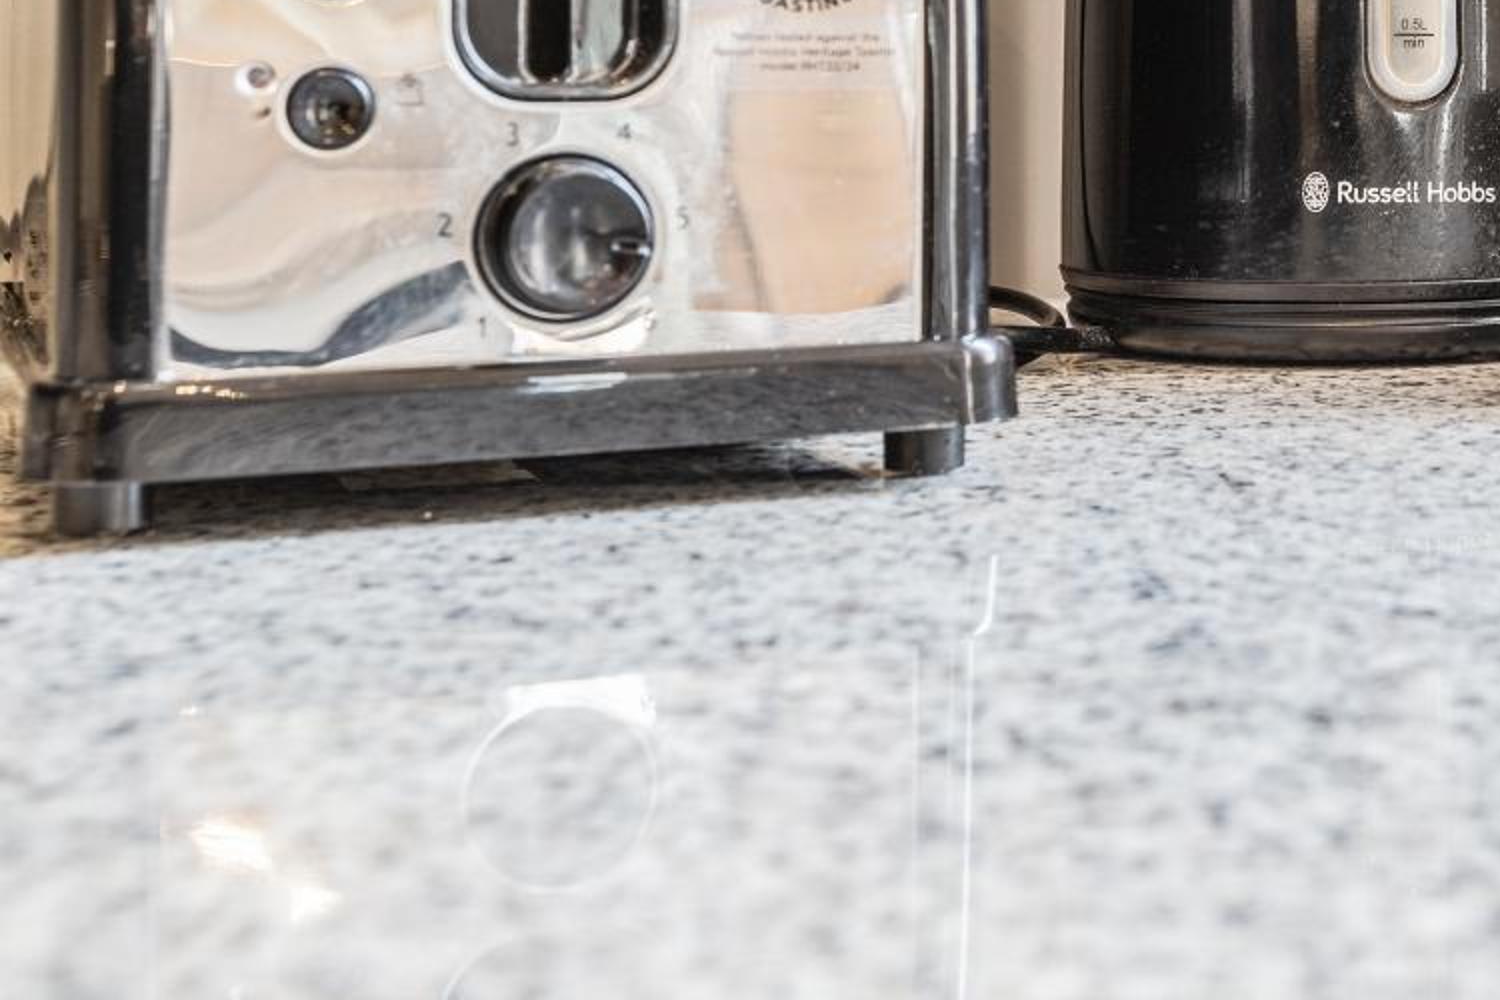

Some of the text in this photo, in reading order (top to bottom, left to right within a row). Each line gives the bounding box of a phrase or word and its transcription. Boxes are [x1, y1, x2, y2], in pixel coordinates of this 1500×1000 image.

[1402, 35, 1425, 49] min
[506, 121, 519, 147] 3
[616, 122, 633, 140] 4
[1336, 179, 1497, 204] Russell Hobbs
[436, 212, 452, 238] 2
